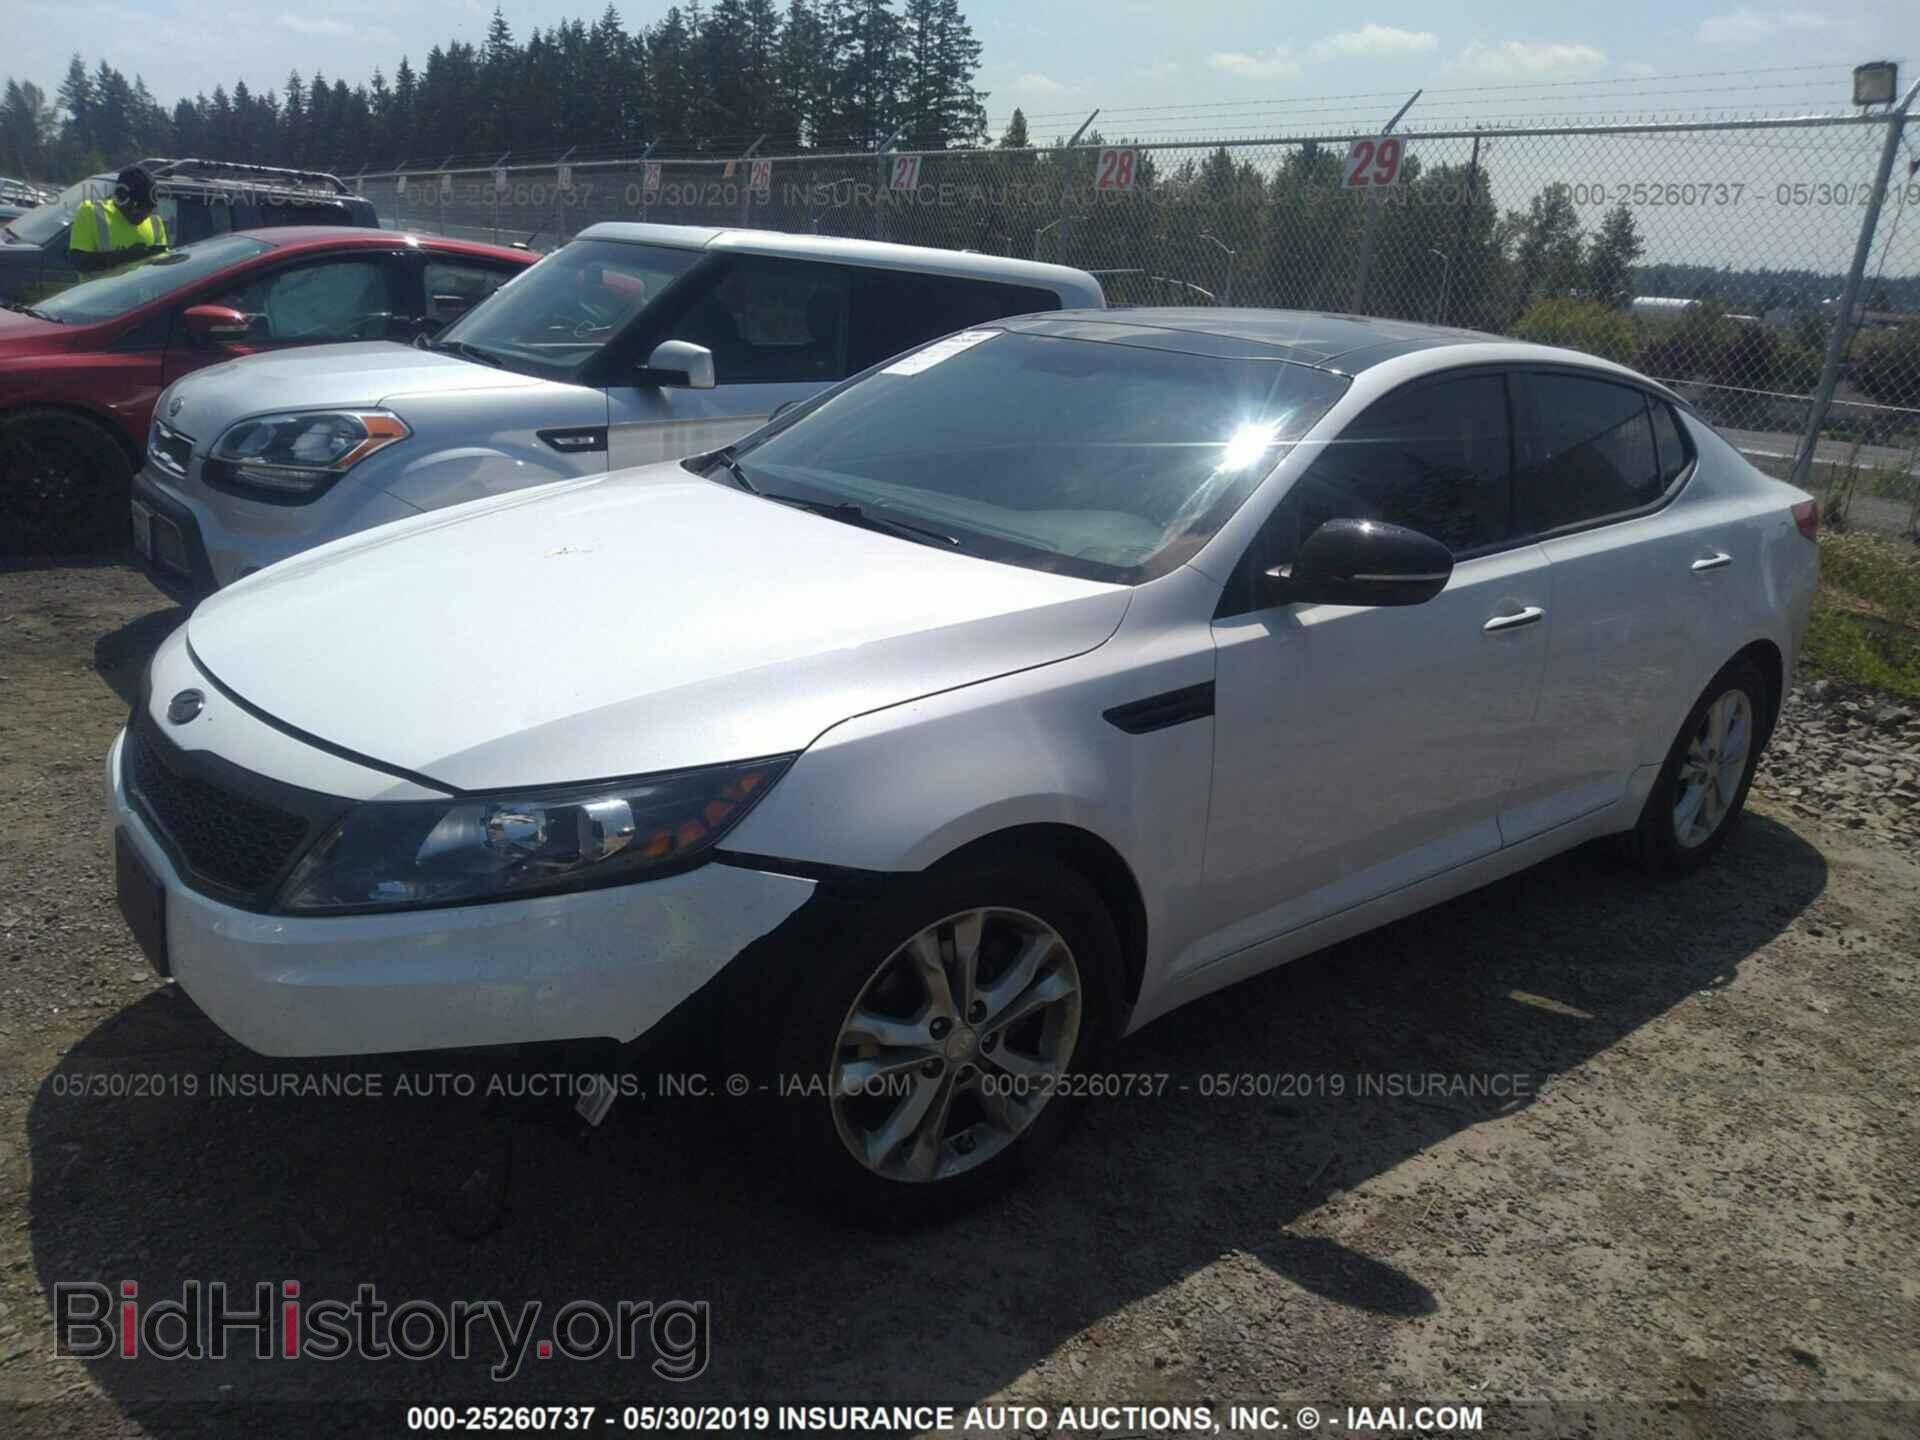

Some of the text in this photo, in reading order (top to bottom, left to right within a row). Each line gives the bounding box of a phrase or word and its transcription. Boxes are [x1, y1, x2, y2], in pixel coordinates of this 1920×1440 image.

[896, 157, 918, 189] 27
[1099, 149, 1133, 190] 28
[1349, 138, 1400, 186] 29
